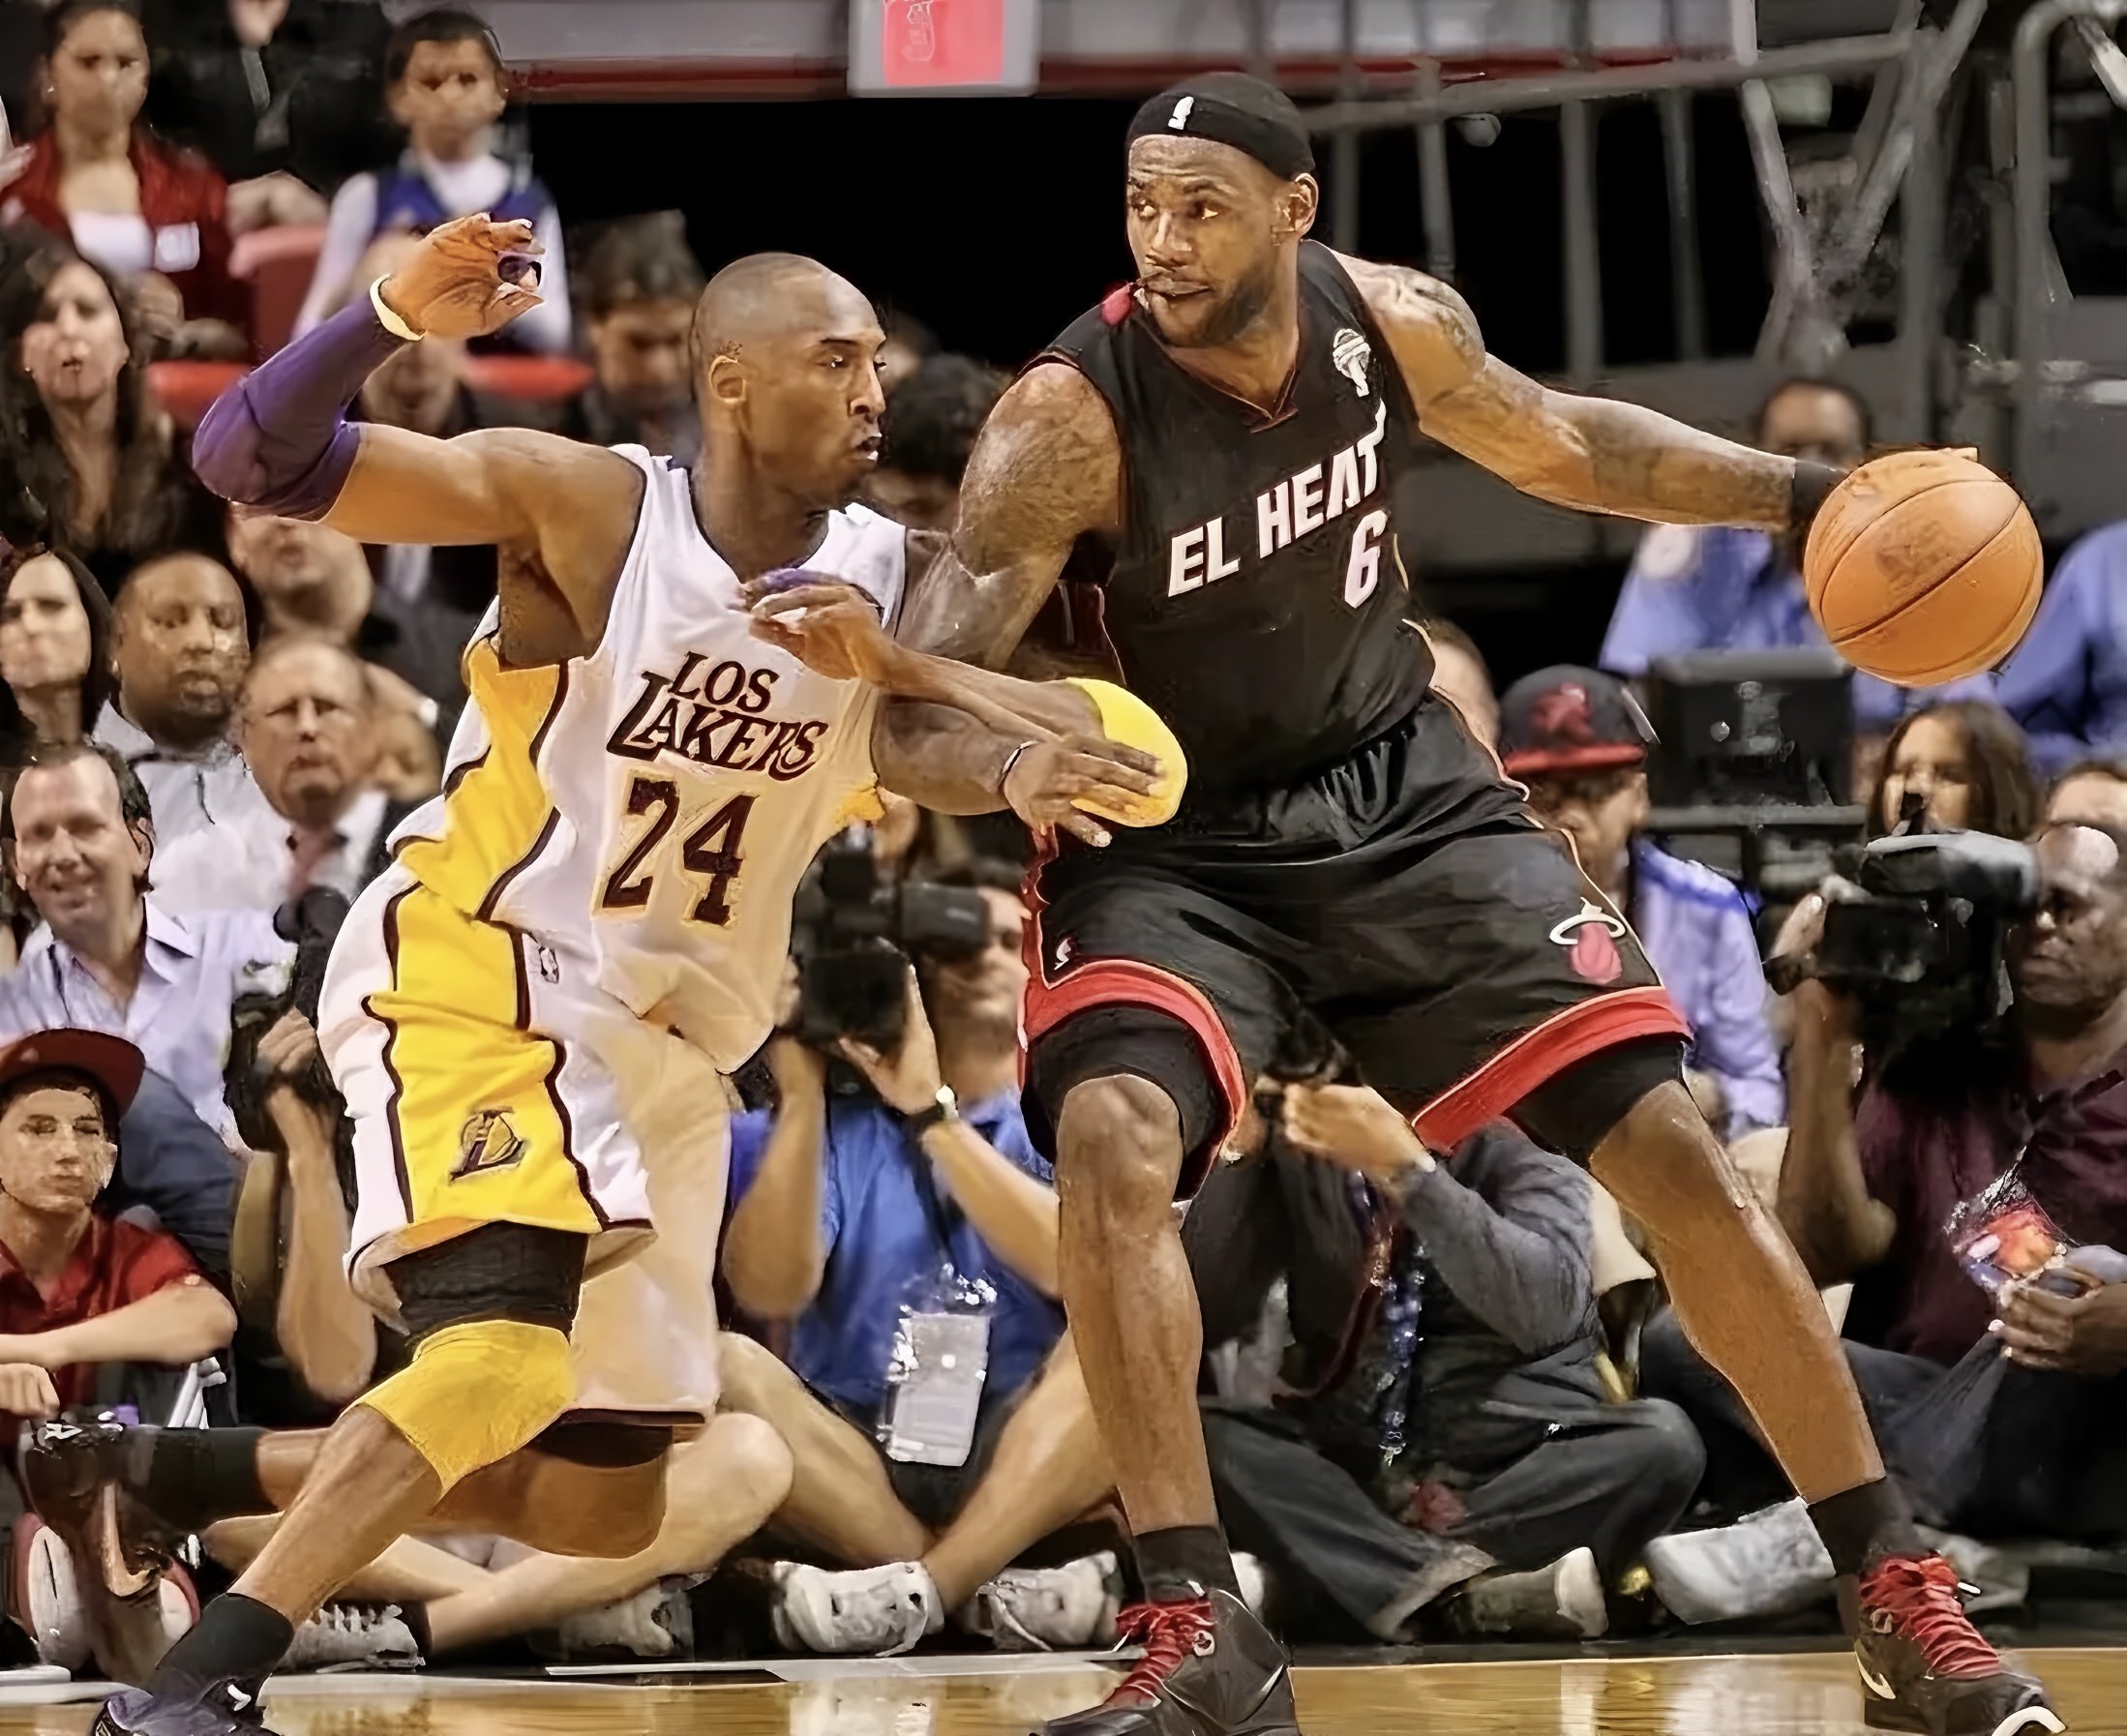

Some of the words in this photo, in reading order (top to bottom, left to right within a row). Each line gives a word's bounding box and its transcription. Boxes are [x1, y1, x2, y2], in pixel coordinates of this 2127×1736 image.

[1168, 516, 1241, 598] EL
[1256, 398, 1387, 559] HEAT
[1344, 509, 1389, 609] 6
[606, 671, 829, 782] LAKERS
[668, 651, 780, 713] LOS
[596, 774, 761, 926] 24
